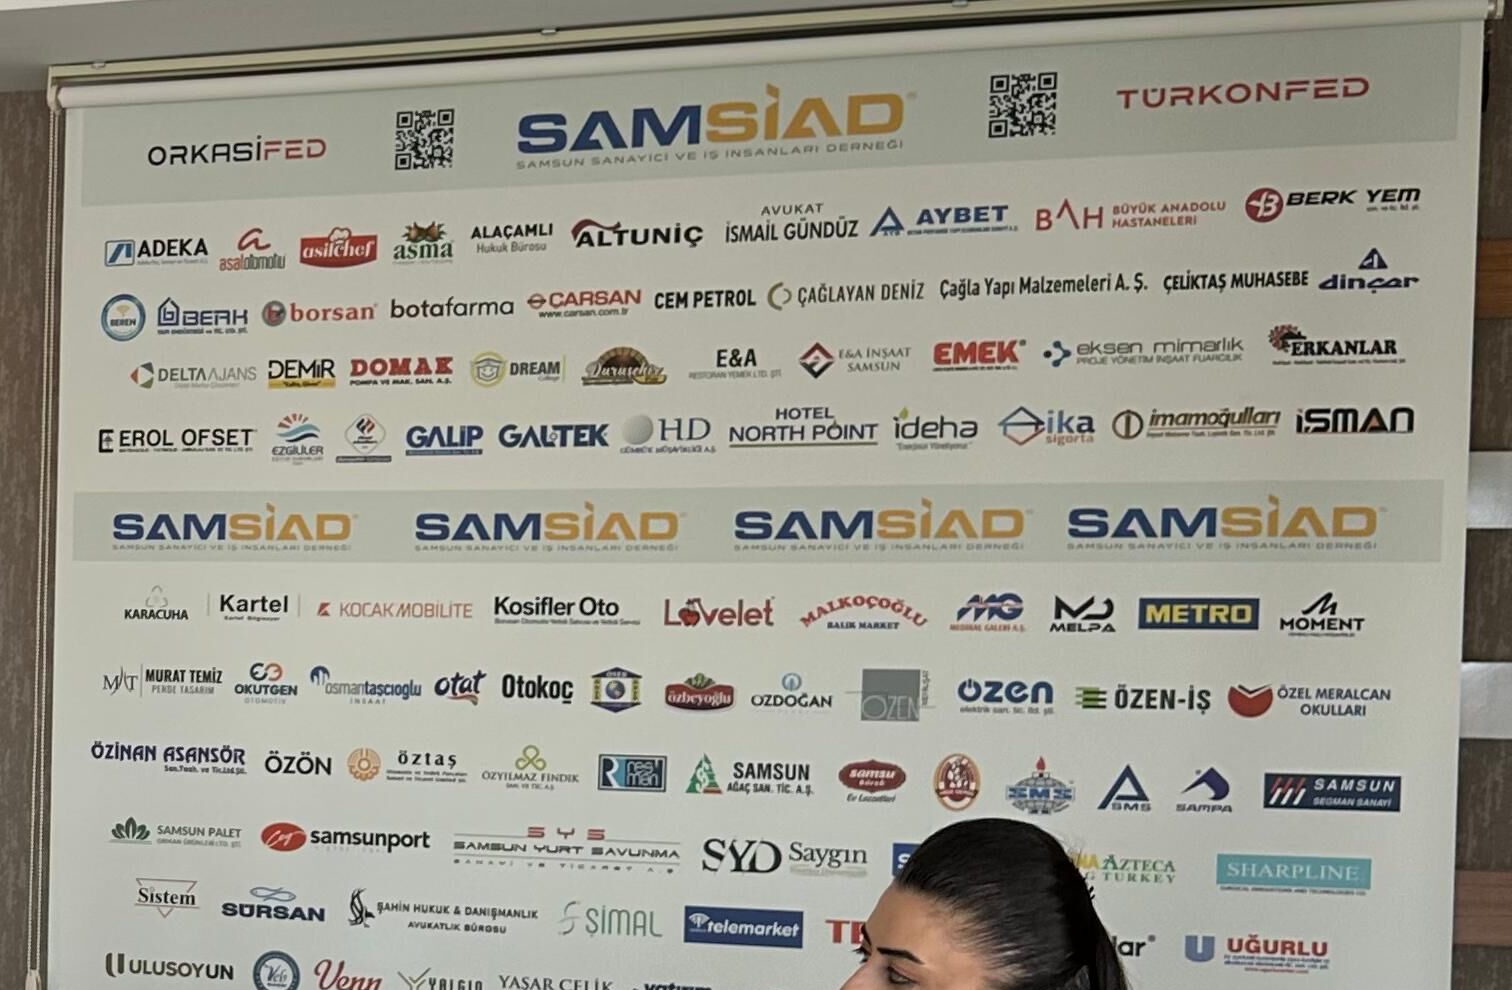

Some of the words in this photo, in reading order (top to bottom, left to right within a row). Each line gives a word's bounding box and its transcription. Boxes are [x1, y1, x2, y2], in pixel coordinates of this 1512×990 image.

[1117, 77, 1369, 109] TÜRKONFED
[517, 158, 584, 169] SAMSUN
[675, 151, 696, 161] VE
[1286, 190, 1357, 206] BERK
[1367, 188, 1420, 203] YEM
[761, 203, 823, 216] AVUKAT
[917, 205, 1008, 225] AYBET
[1113, 202, 1156, 215] BÜYÜK
[1161, 199, 1226, 213] ANADOLU
[471, 223, 553, 239] ALAÇAMLI
[726, 220, 778, 243] İSMAİL
[784, 216, 858, 240] GÜNDÜZ
[137, 238, 208, 257] ADEKA
[393, 241, 453, 260] asma
[477, 242, 508, 253] Hukuk
[511, 241, 547, 252] Bürosu
[940, 279, 980, 301] Çağla
[985, 278, 1014, 299] Yapı
[1019, 273, 1111, 294] Malzemeleri
[1164, 270, 1226, 294] ÇELİKTAŞ
[1231, 271, 1308, 288] MUHASEBE
[1319, 274, 1419, 294] dinçar
[655, 292, 688, 309] CEM
[693, 289, 756, 308] PETROL
[798, 283, 874, 307] ÇAĞLAYAN
[881, 279, 924, 300] DENİZ
[290, 303, 376, 321] borsan
[390, 297, 514, 318] botafarma
[839, 349, 862, 359] E&A
[934, 340, 1019, 365] EMEK
[1077, 342, 1143, 355] eksen
[1154, 337, 1244, 353] mimarlık
[1291, 340, 1397, 356] ERKANLAR
[350, 357, 453, 376] DOMAK
[717, 349, 757, 367] E&A
[848, 362, 900, 372] SAMSUN
[510, 361, 560, 375] DREAM
[776, 407, 834, 420] HOTEL
[1047, 411, 1095, 432] ika
[659, 418, 711, 441] HD
[729, 425, 805, 442] NORTH
[814, 421, 879, 441] POINT
[893, 412, 978, 440] ideha
[120, 429, 173, 446] EROL
[182, 429, 254, 446] OFSET
[1045, 433, 1094, 446] sigorta
[220, 595, 288, 612] Kartel
[495, 597, 575, 616] Kosifler
[579, 597, 619, 616] Oto
[800, 596, 927, 629] MALKOÇOĞLU
[125, 609, 188, 620] KARACUHA
[1145, 604, 1252, 623] METRO
[859, 621, 900, 630] MARKET
[1050, 623, 1116, 632] MELPA
[1280, 618, 1365, 633] MOMENT
[145, 669, 186, 682] MURAT
[188, 666, 223, 684] TEMİZ
[152, 685, 176, 694] PERDE
[180, 685, 214, 694] TASARIM
[235, 684, 297, 696] OKUTGEN
[1277, 684, 1312, 701] ÖZEL
[1315, 688, 1391, 700] MERALCAN
[1115, 684, 1210, 714] ÖZEN-İŞ
[1300, 704, 1366, 716] OKULLARI
[163, 745, 245, 765] ASANSÖR
[265, 751, 331, 775] ÖZÖN
[398, 750, 456, 769] öztaş
[734, 762, 809, 780] SAMSUN
[849, 769, 896, 778] samsu
[727, 781, 750, 794] AĞAÇ
[753, 783, 774, 794] SAN.
[1314, 778, 1395, 792] SAMSUN
[1112, 802, 1151, 811] SMS
[1176, 803, 1232, 813] SAMPA
[1313, 797, 1355, 808] SEGMAN
[157, 825, 205, 836] SAMSUN
[208, 827, 241, 838] PALET
[311, 831, 430, 853] samsunport
[454, 840, 527, 853] SAMSUN
[532, 845, 584, 856] YURT
[591, 847, 680, 858] SAVUNMA
[703, 839, 782, 873] SYD
[789, 842, 867, 868] Saygın
[1103, 870, 1176, 884] TURKEY
[1227, 861, 1359, 882] SHARPLINE
[137, 886, 196, 906] Sistem
[221, 902, 326, 922] SÜRSAN
[377, 901, 410, 914] ŞAHİN
[413, 902, 450, 915] HUKUK
[453, 904, 461, 915] &
[464, 905, 538, 921] DANIŞMANLIK
[407, 921, 461, 932] AVUKATLIK
[464, 923, 506, 934] BÜROSU
[586, 905, 662, 937] ŞİMAL
[707, 921, 800, 938] telemarket
[1228, 935, 1327, 957] UĞURLU
[129, 960, 233, 980] ULUSOYUN
